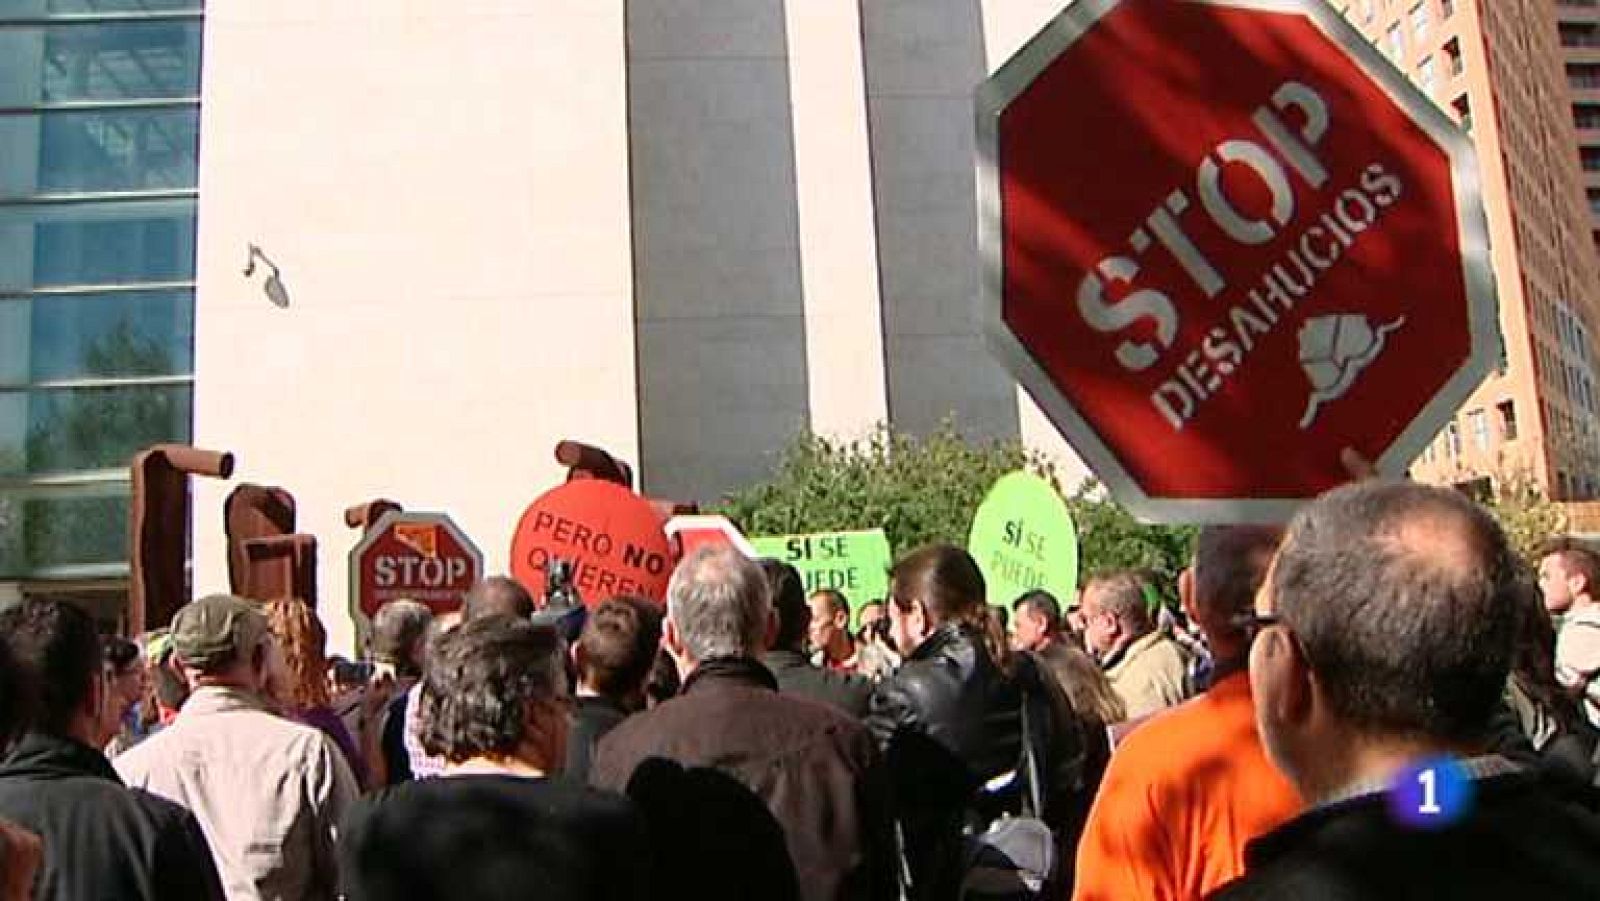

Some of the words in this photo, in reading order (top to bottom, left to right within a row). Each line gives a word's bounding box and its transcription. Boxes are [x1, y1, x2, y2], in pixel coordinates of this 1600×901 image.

[1077, 81, 1328, 371] STOP
[1152, 163, 1401, 431] DESAHUCIOS
[533, 510, 613, 554] PERO
[622, 543, 664, 576] NO
[819, 535, 851, 559] SE
[1025, 531, 1046, 562] SE
[375, 556, 466, 586] STOP
